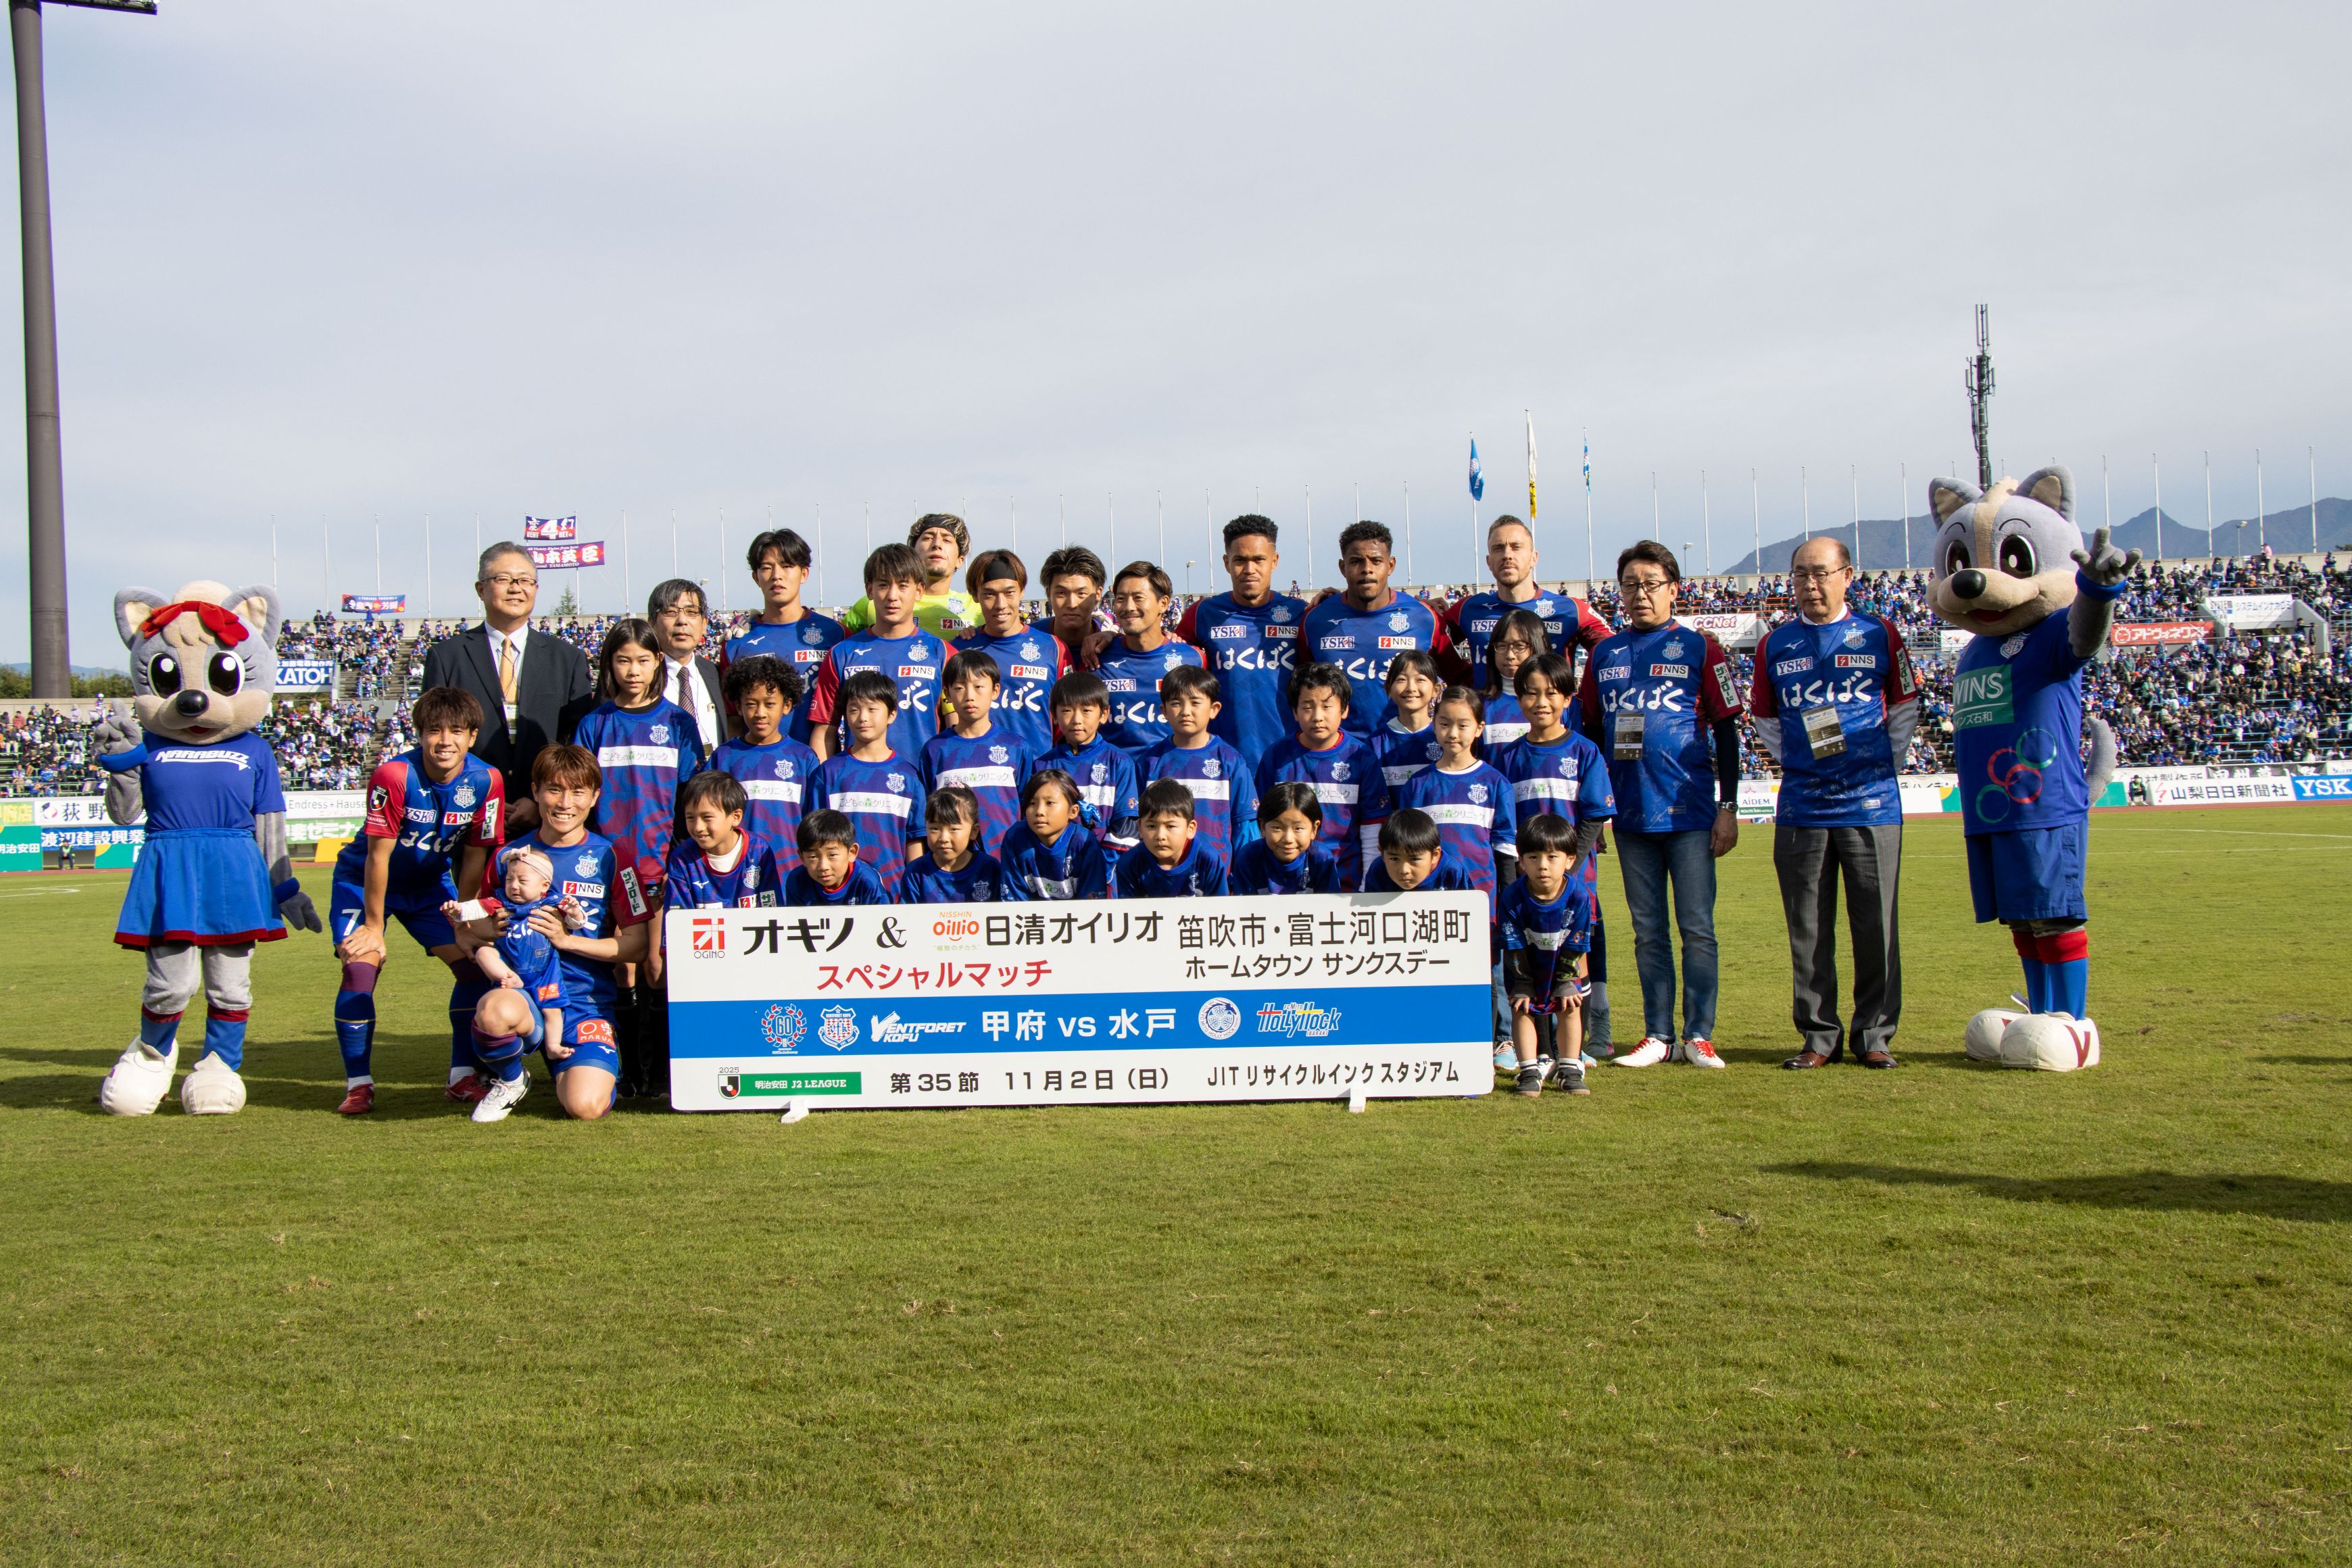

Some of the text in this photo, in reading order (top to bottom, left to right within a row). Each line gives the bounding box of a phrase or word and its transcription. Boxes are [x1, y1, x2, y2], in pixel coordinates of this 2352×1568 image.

[1694, 616, 1736, 629] CCNet
[1212, 627, 1236, 637] YSK
[1279, 627, 1298, 636] NNS
[1321, 637, 1344, 649] YSK
[1393, 637, 1413, 646] NNS
[1217, 641, 1296, 670] はくばく
[1850, 656, 1873, 664] NNS
[912, 666, 935, 675] NNS
[1025, 666, 1046, 676] NNS
[1599, 667, 1620, 681] YSK
[1664, 666, 1687, 675] NNS
[1778, 659, 1804, 675] YSK
[276, 667, 333, 684] KATOH
[1782, 670, 1873, 707] はくばく
[1602, 680, 1684, 712] はくばく
[602, 752, 668, 762] こどもの森クリニック
[2171, 784, 2288, 800] 山梨日日新聞社
[2295, 779, 2352, 796] YSK
[289, 800, 327, 809] Endress
[337, 800, 366, 808] Hause
[839, 797, 902, 810] こどもの森クリニック
[459, 812, 472, 820] NN
[41, 829, 145, 848] 渡辺建設興業
[578, 883, 602, 894] NNS
[341, 909, 362, 936] 7
[986, 911, 1164, 946] 日清オイリオ
[1177, 909, 1471, 950] 笛吹市・富士河口湖町
[742, 916, 907, 955] オギノ &
[1185, 950, 1450, 979] ホームタウン サンクスデー
[816, 960, 1052, 990] スペシャルマッチ
[776, 1016, 792, 1035] 60
[871, 1010, 966, 1042] VENTFORET
[982, 1009, 1046, 1042] 甲府
[1108, 1008, 1176, 1039] 水戸
[883, 1033, 919, 1043] KOFU
[755, 1079, 846, 1089] 明治安田 J2 LEAGUE
